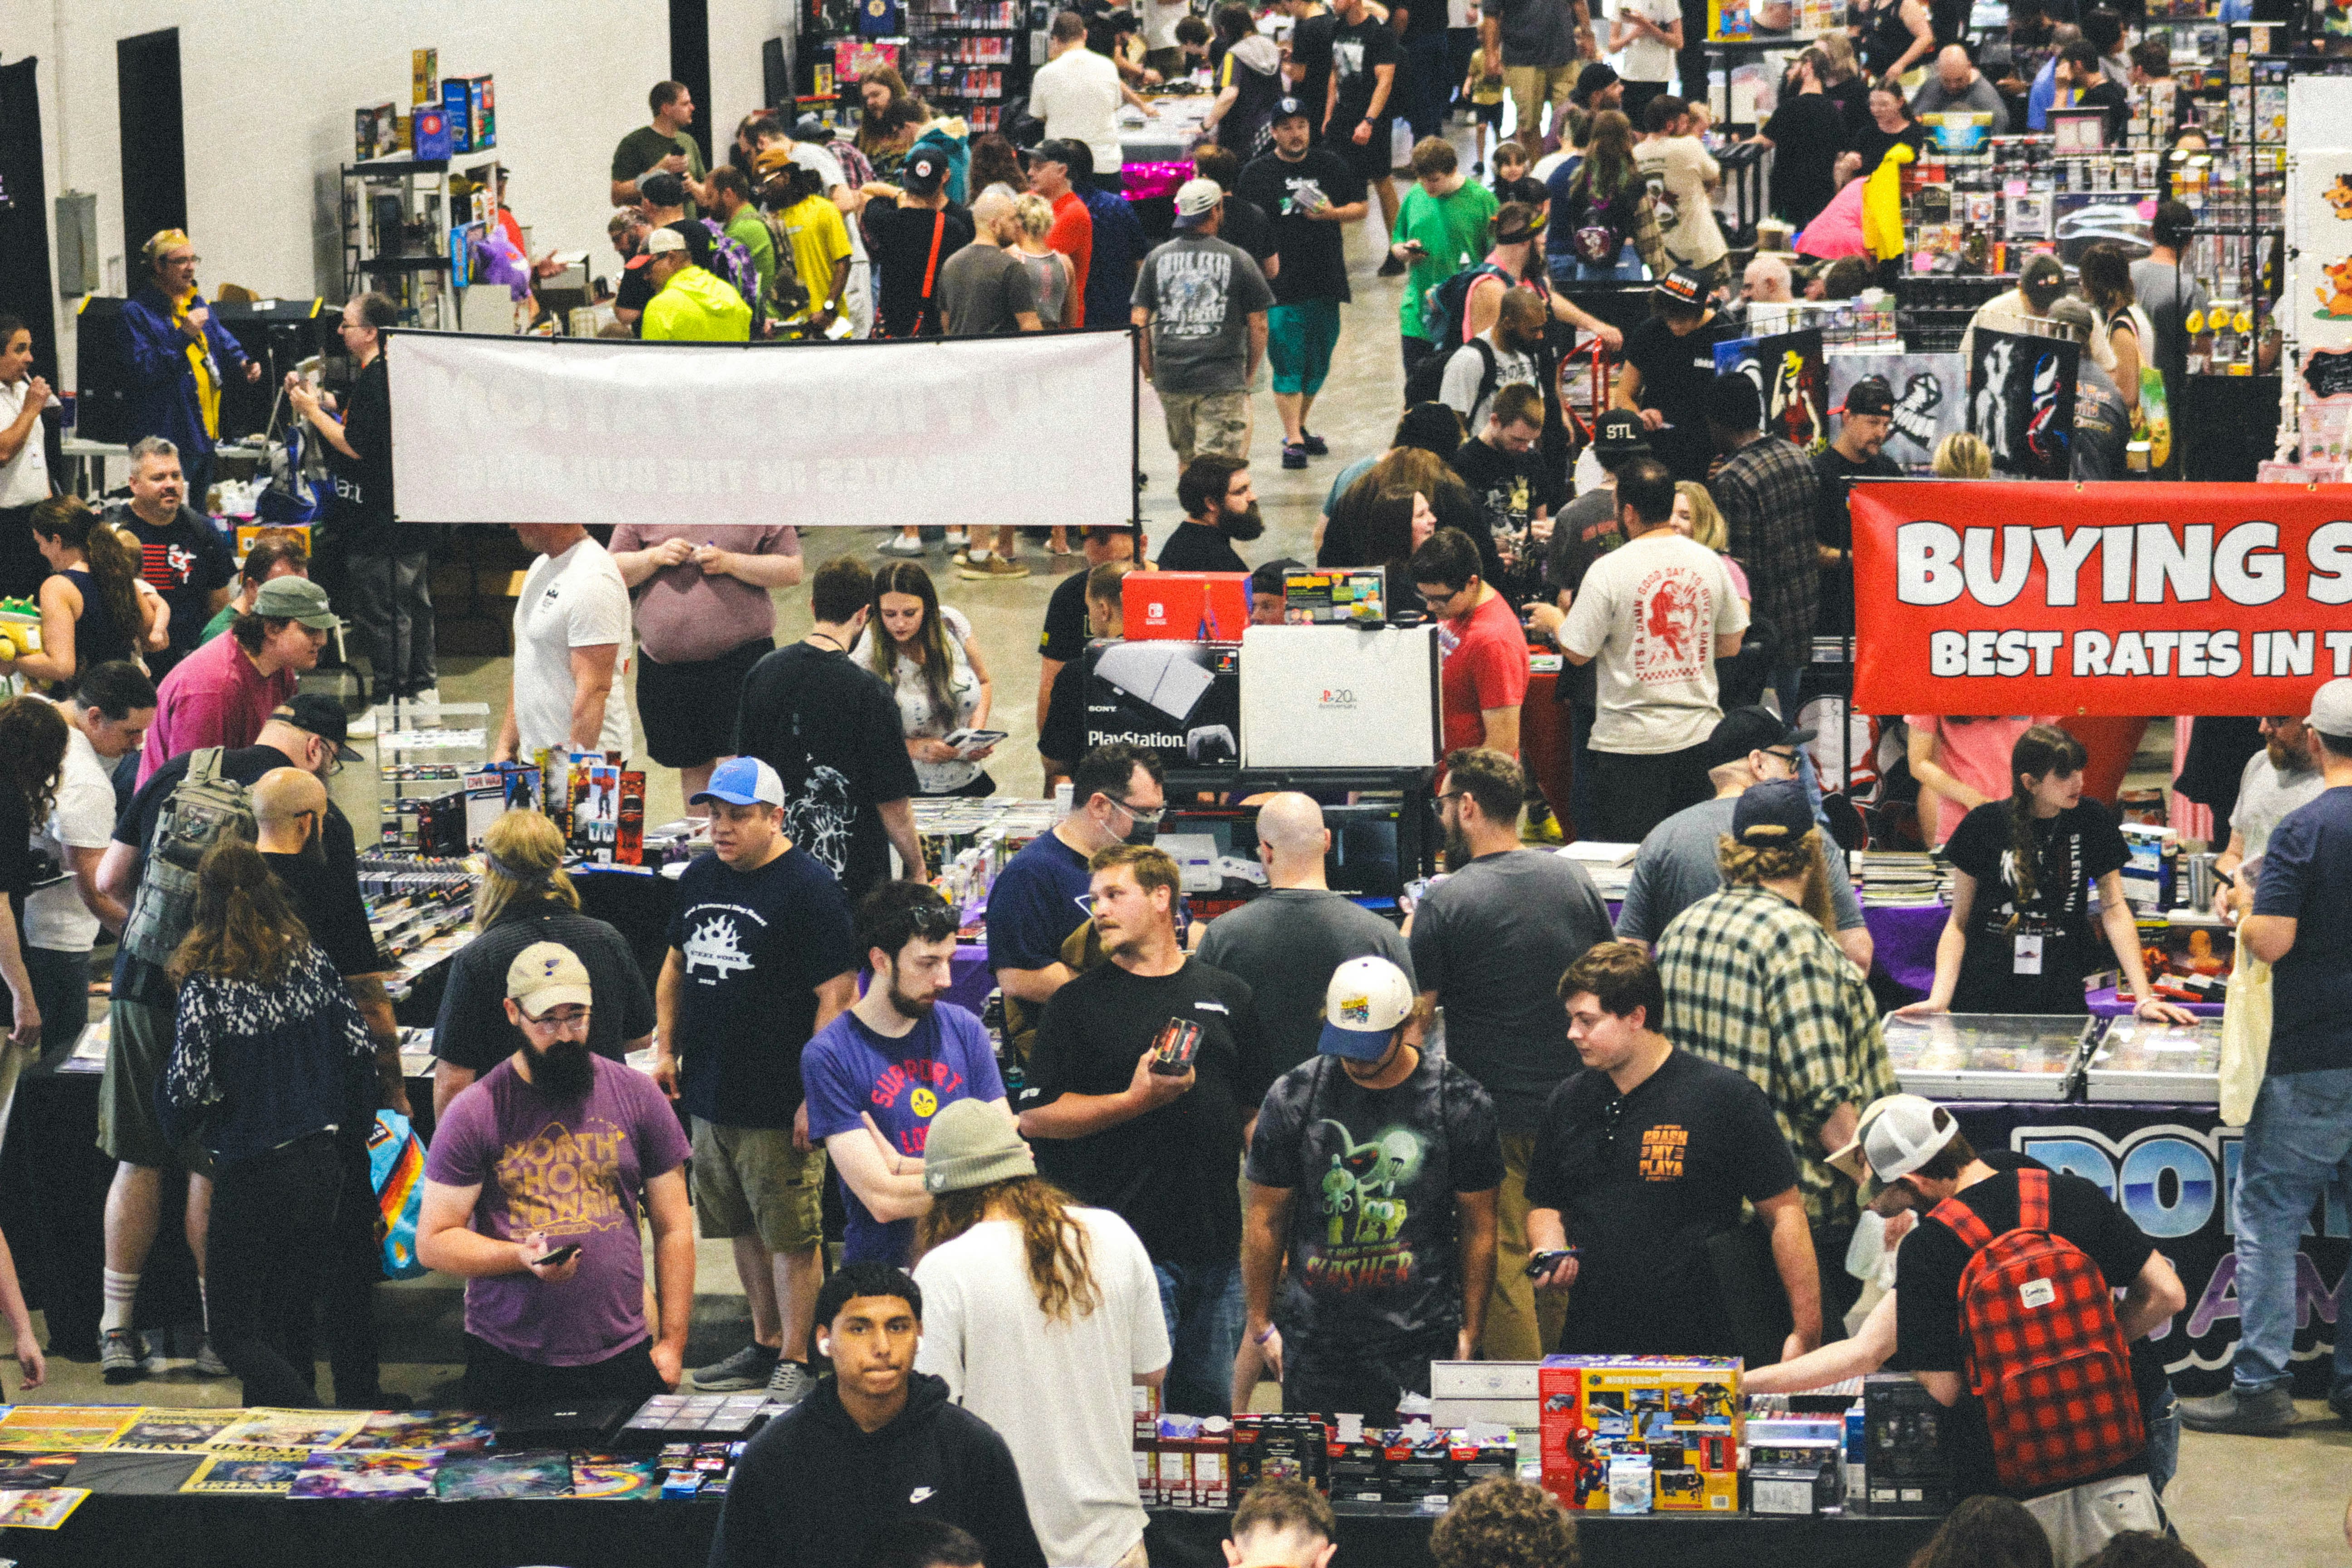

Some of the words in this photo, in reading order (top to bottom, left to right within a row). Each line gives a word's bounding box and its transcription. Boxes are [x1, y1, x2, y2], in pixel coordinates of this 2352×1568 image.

[1606, 423, 1636, 439] STL
[1666, 567, 1685, 577] DAY
[1896, 520, 2286, 607] BUYING
[1638, 570, 1662, 595] GOOD
[1690, 571, 1703, 587] TO
[1700, 588, 1710, 613] GIVE
[1634, 600, 1644, 632] DAMN
[1930, 629, 2063, 677] BEST
[2073, 629, 2242, 678] RATES
[2252, 629, 2316, 677] IN
[1088, 730, 1186, 748] PlayStation
[2070, 833, 2081, 888] SILENT
[871, 1059, 963, 1108] SUPPORT
[1642, 1130, 1689, 1146] CRASH
[1651, 1145, 1675, 1161] MY
[1639, 1160, 1684, 1176] PLAYA
